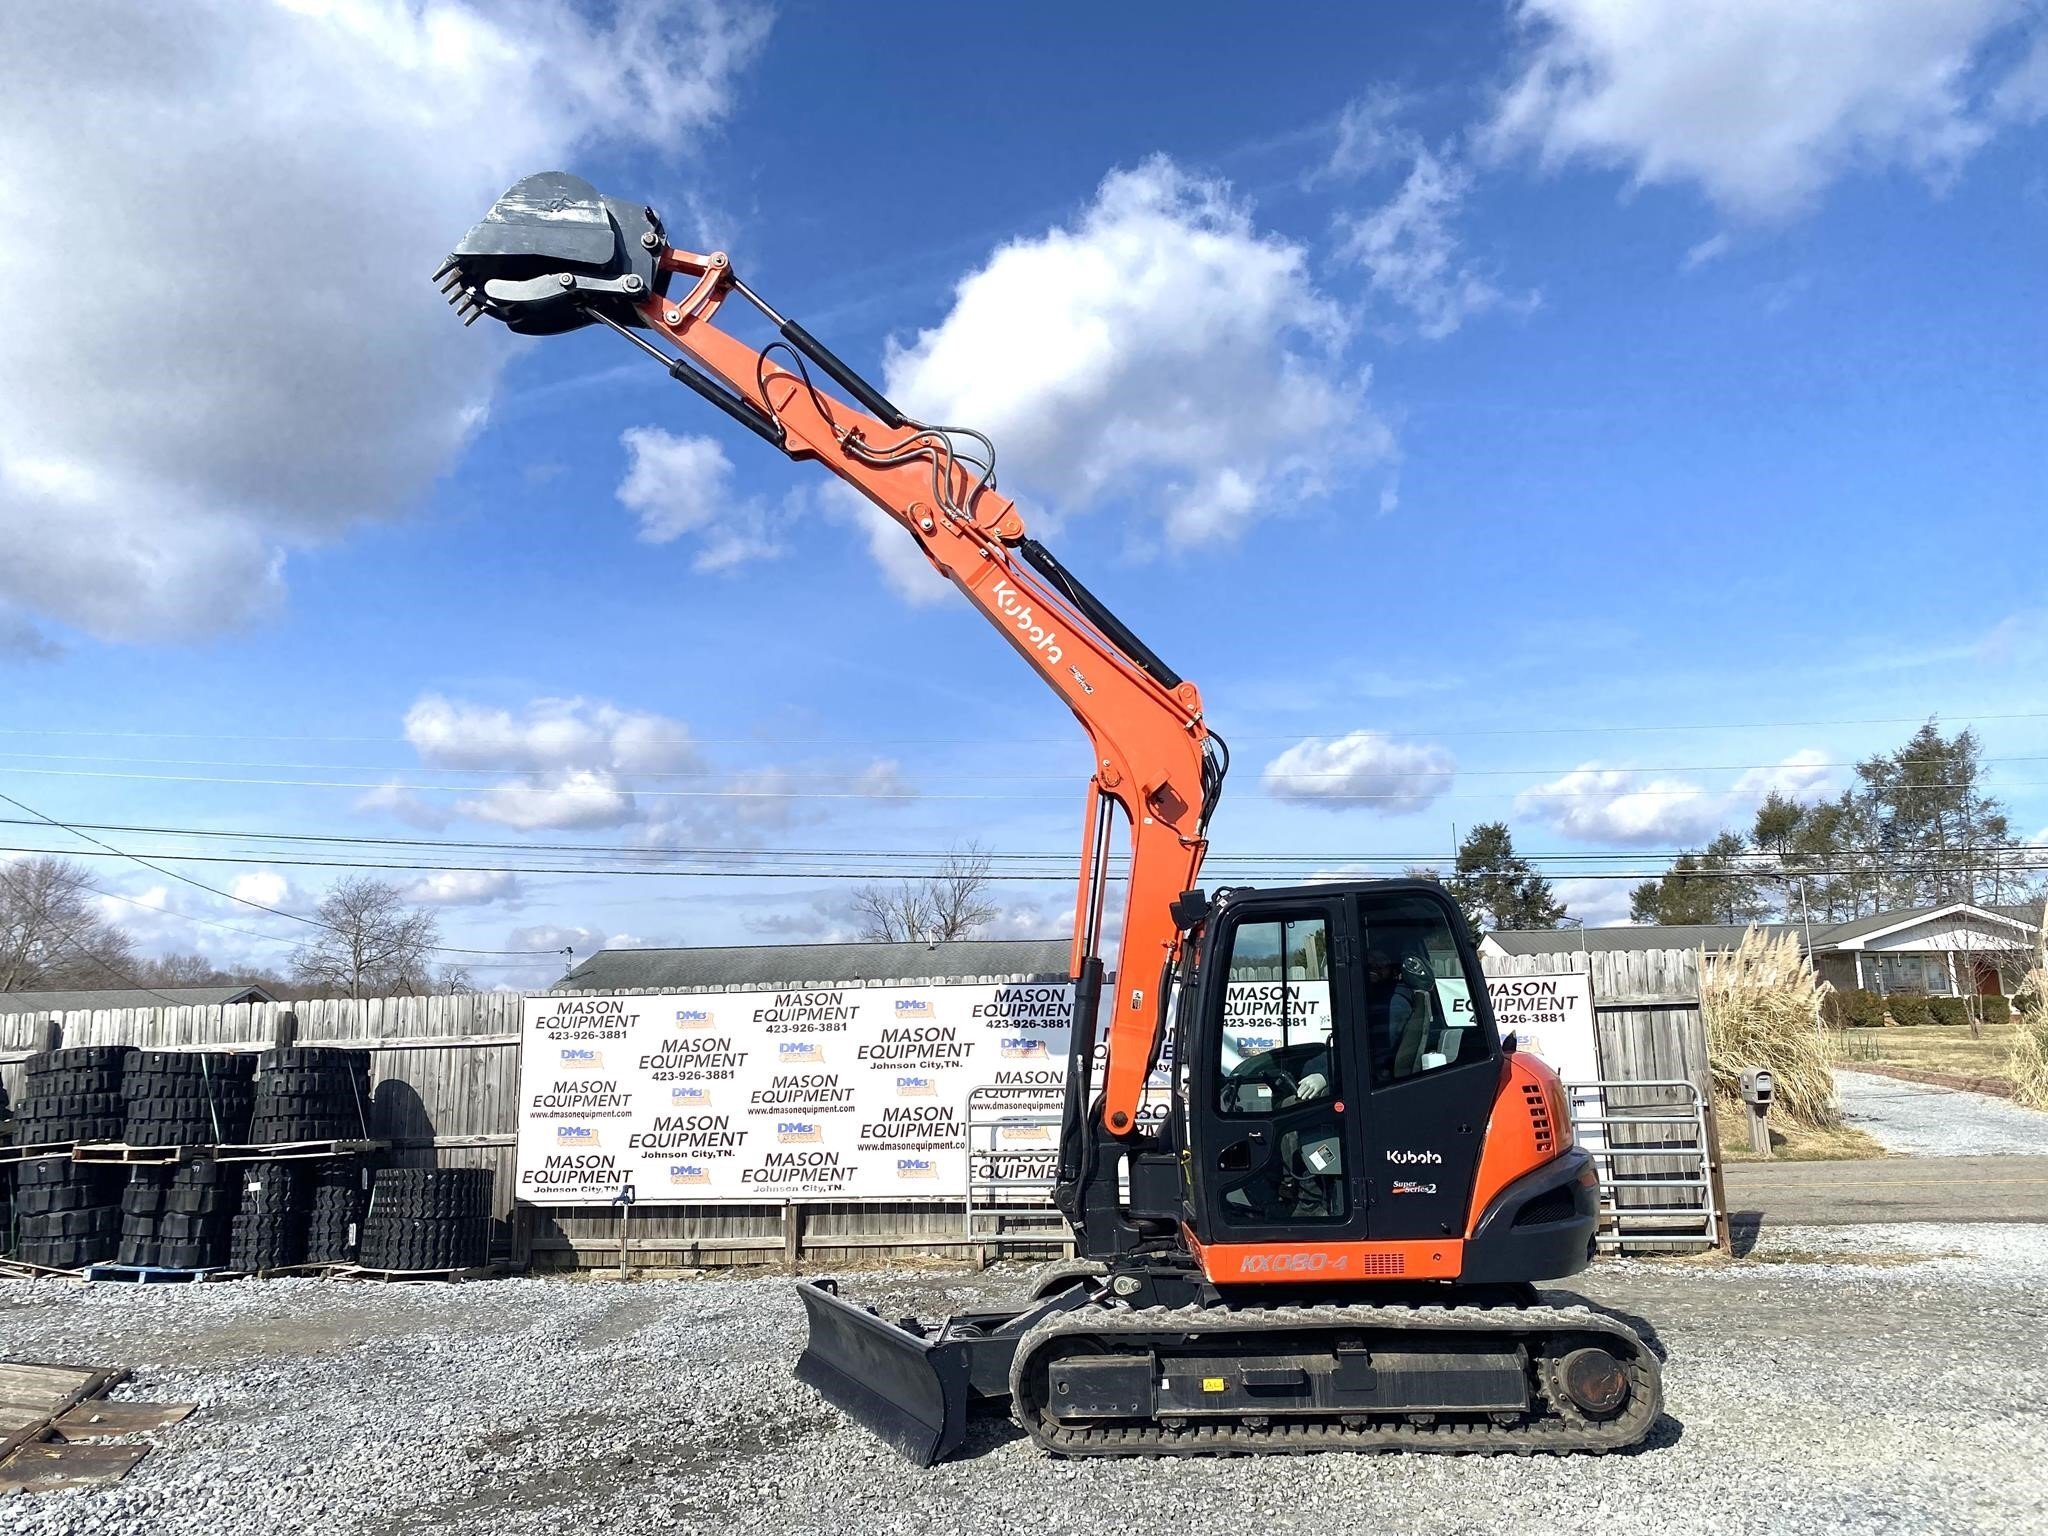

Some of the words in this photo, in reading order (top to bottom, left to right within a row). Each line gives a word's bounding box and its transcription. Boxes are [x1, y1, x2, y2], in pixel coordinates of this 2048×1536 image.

[992, 580, 1063, 665] Kubota
[775, 992, 842, 1007] MASON
[994, 989, 1065, 1002] MASON
[1227, 986, 1300, 1000] MASON
[557, 1001, 623, 1014] MASON
[1224, 1001, 1319, 1016] QUIPMENT
[1453, 996, 1578, 1012] EIPMENT
[753, 1006, 860, 1022] EQUIPMENT
[1469, 1013, 1566, 1024] 4-926-3881
[536, 1015, 640, 1029] EQUIPMENT
[766, 1023, 846, 1033] 423-926-3881
[986, 1019, 1070, 1030] 423-926-3881
[548, 1031, 626, 1040] 423-926-3881
[881, 1027, 956, 1043] MASON
[662, 1038, 731, 1053] MASON
[858, 1043, 975, 1059] EQUIPMENT
[639, 1053, 748, 1069] EQUIPMENT
[870, 1062, 916, 1070] Johnson
[652, 1070, 734, 1080] 423-926-3881
[772, 1074, 838, 1088] MASON
[995, 1071, 1063, 1084] MASON
[553, 1081, 616, 1093] MASON
[974, 1089, 1064, 1098] EQUIPMEN
[533, 1094, 632, 1107] EQUIPMENT
[751, 1088, 854, 1103] EQUIPMENT
[748, 1105, 855, 1115] www.dmasonequipment.com
[970, 1102, 1064, 1111] www.dmasonequipment
[530, 1111, 631, 1119] www.dmasonequipment.com
[883, 1107, 953, 1121] MASON
[654, 1116, 729, 1131] MASON
[629, 1132, 748, 1148] EQUIPMENT
[858, 1141, 965, 1152] www.dmasonequipment.co
[545, 1155, 615, 1168] MASON
[765, 1152, 839, 1167] MASON
[1386, 1150, 1442, 1164] Kubota
[522, 1170, 633, 1183] EQUIPMENT
[742, 1167, 858, 1182] EQUIPMENT
[971, 1164, 1056, 1178] EQUIPME
[753, 1184, 798, 1193] Johnson
[1393, 1180, 1417, 1188] Super
[1240, 1253, 1348, 1272] KX080-4
